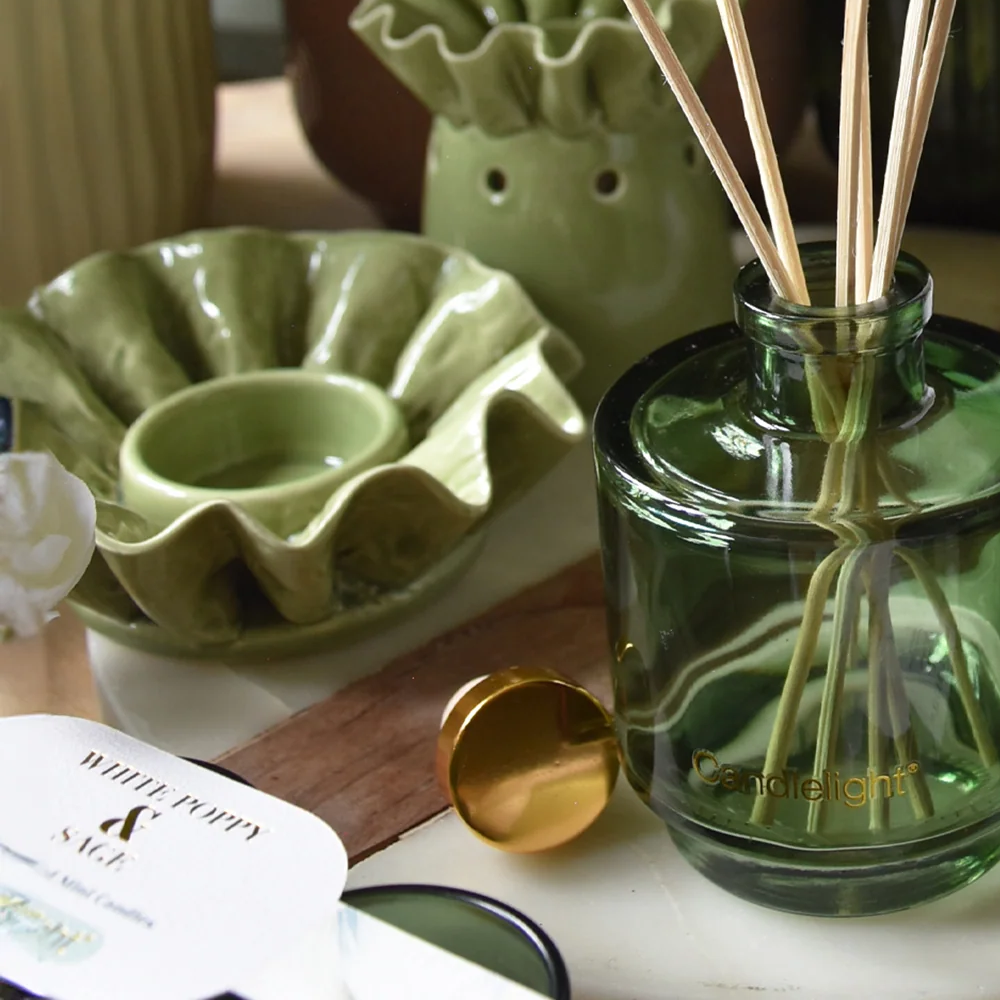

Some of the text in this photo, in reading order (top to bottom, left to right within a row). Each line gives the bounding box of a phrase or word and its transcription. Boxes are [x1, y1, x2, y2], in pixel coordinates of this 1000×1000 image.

[79, 750, 272, 842] WHITE POPPY
[99, 805, 163, 842] &
[50, 826, 137, 872] SAGE
